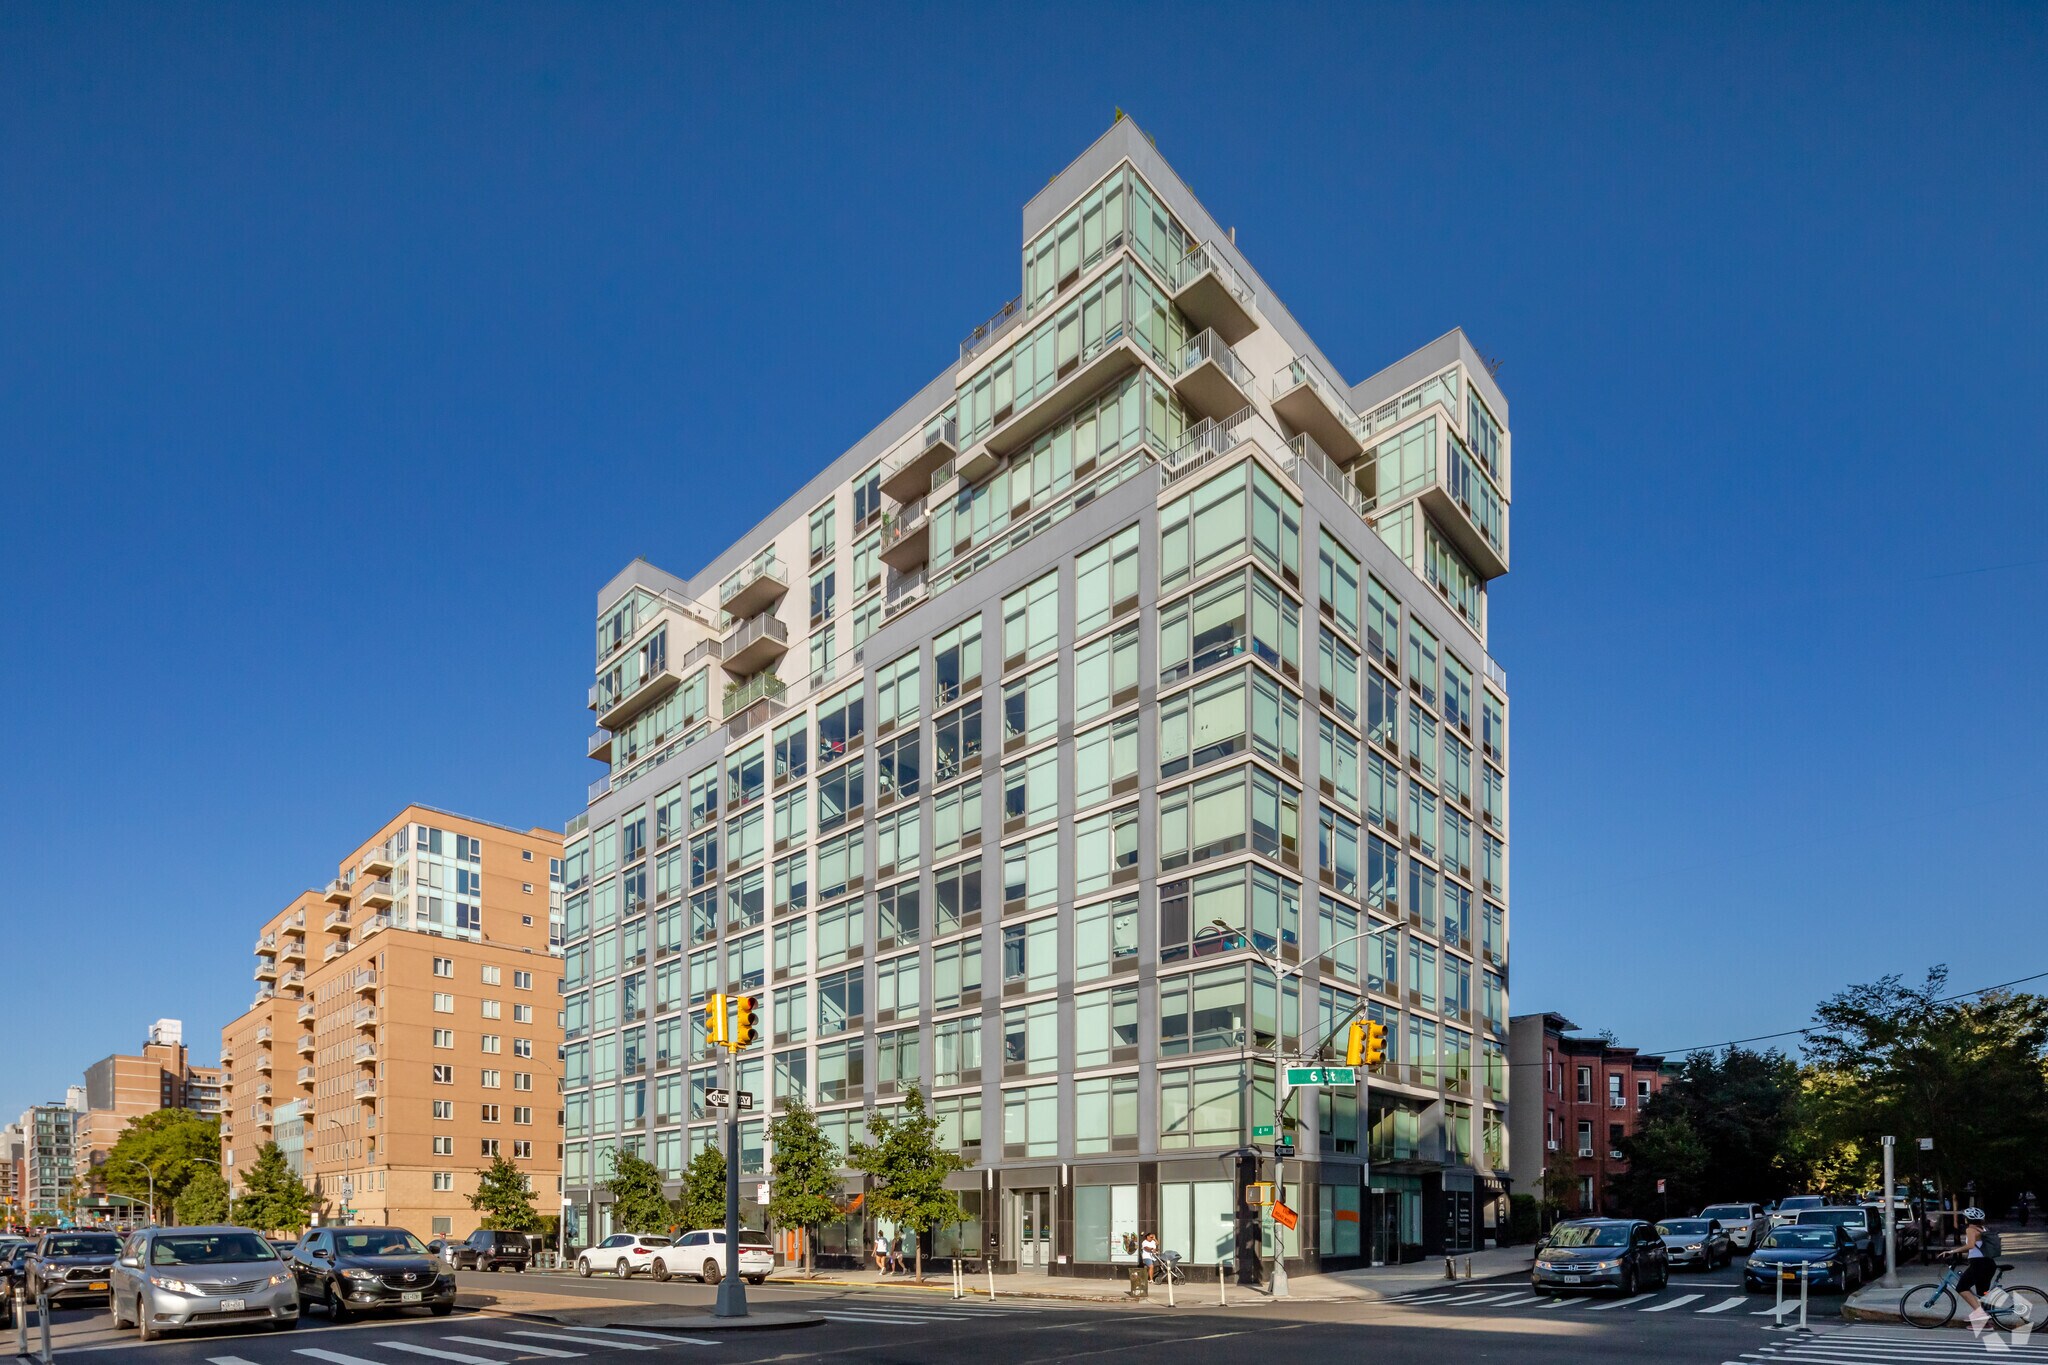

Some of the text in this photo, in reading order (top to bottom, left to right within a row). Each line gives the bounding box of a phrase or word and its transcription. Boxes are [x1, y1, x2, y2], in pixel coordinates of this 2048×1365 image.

[1310, 1071, 1318, 1082] 6
[711, 1093, 727, 1103] ONE
[1258, 1127, 1263, 1135] 4
